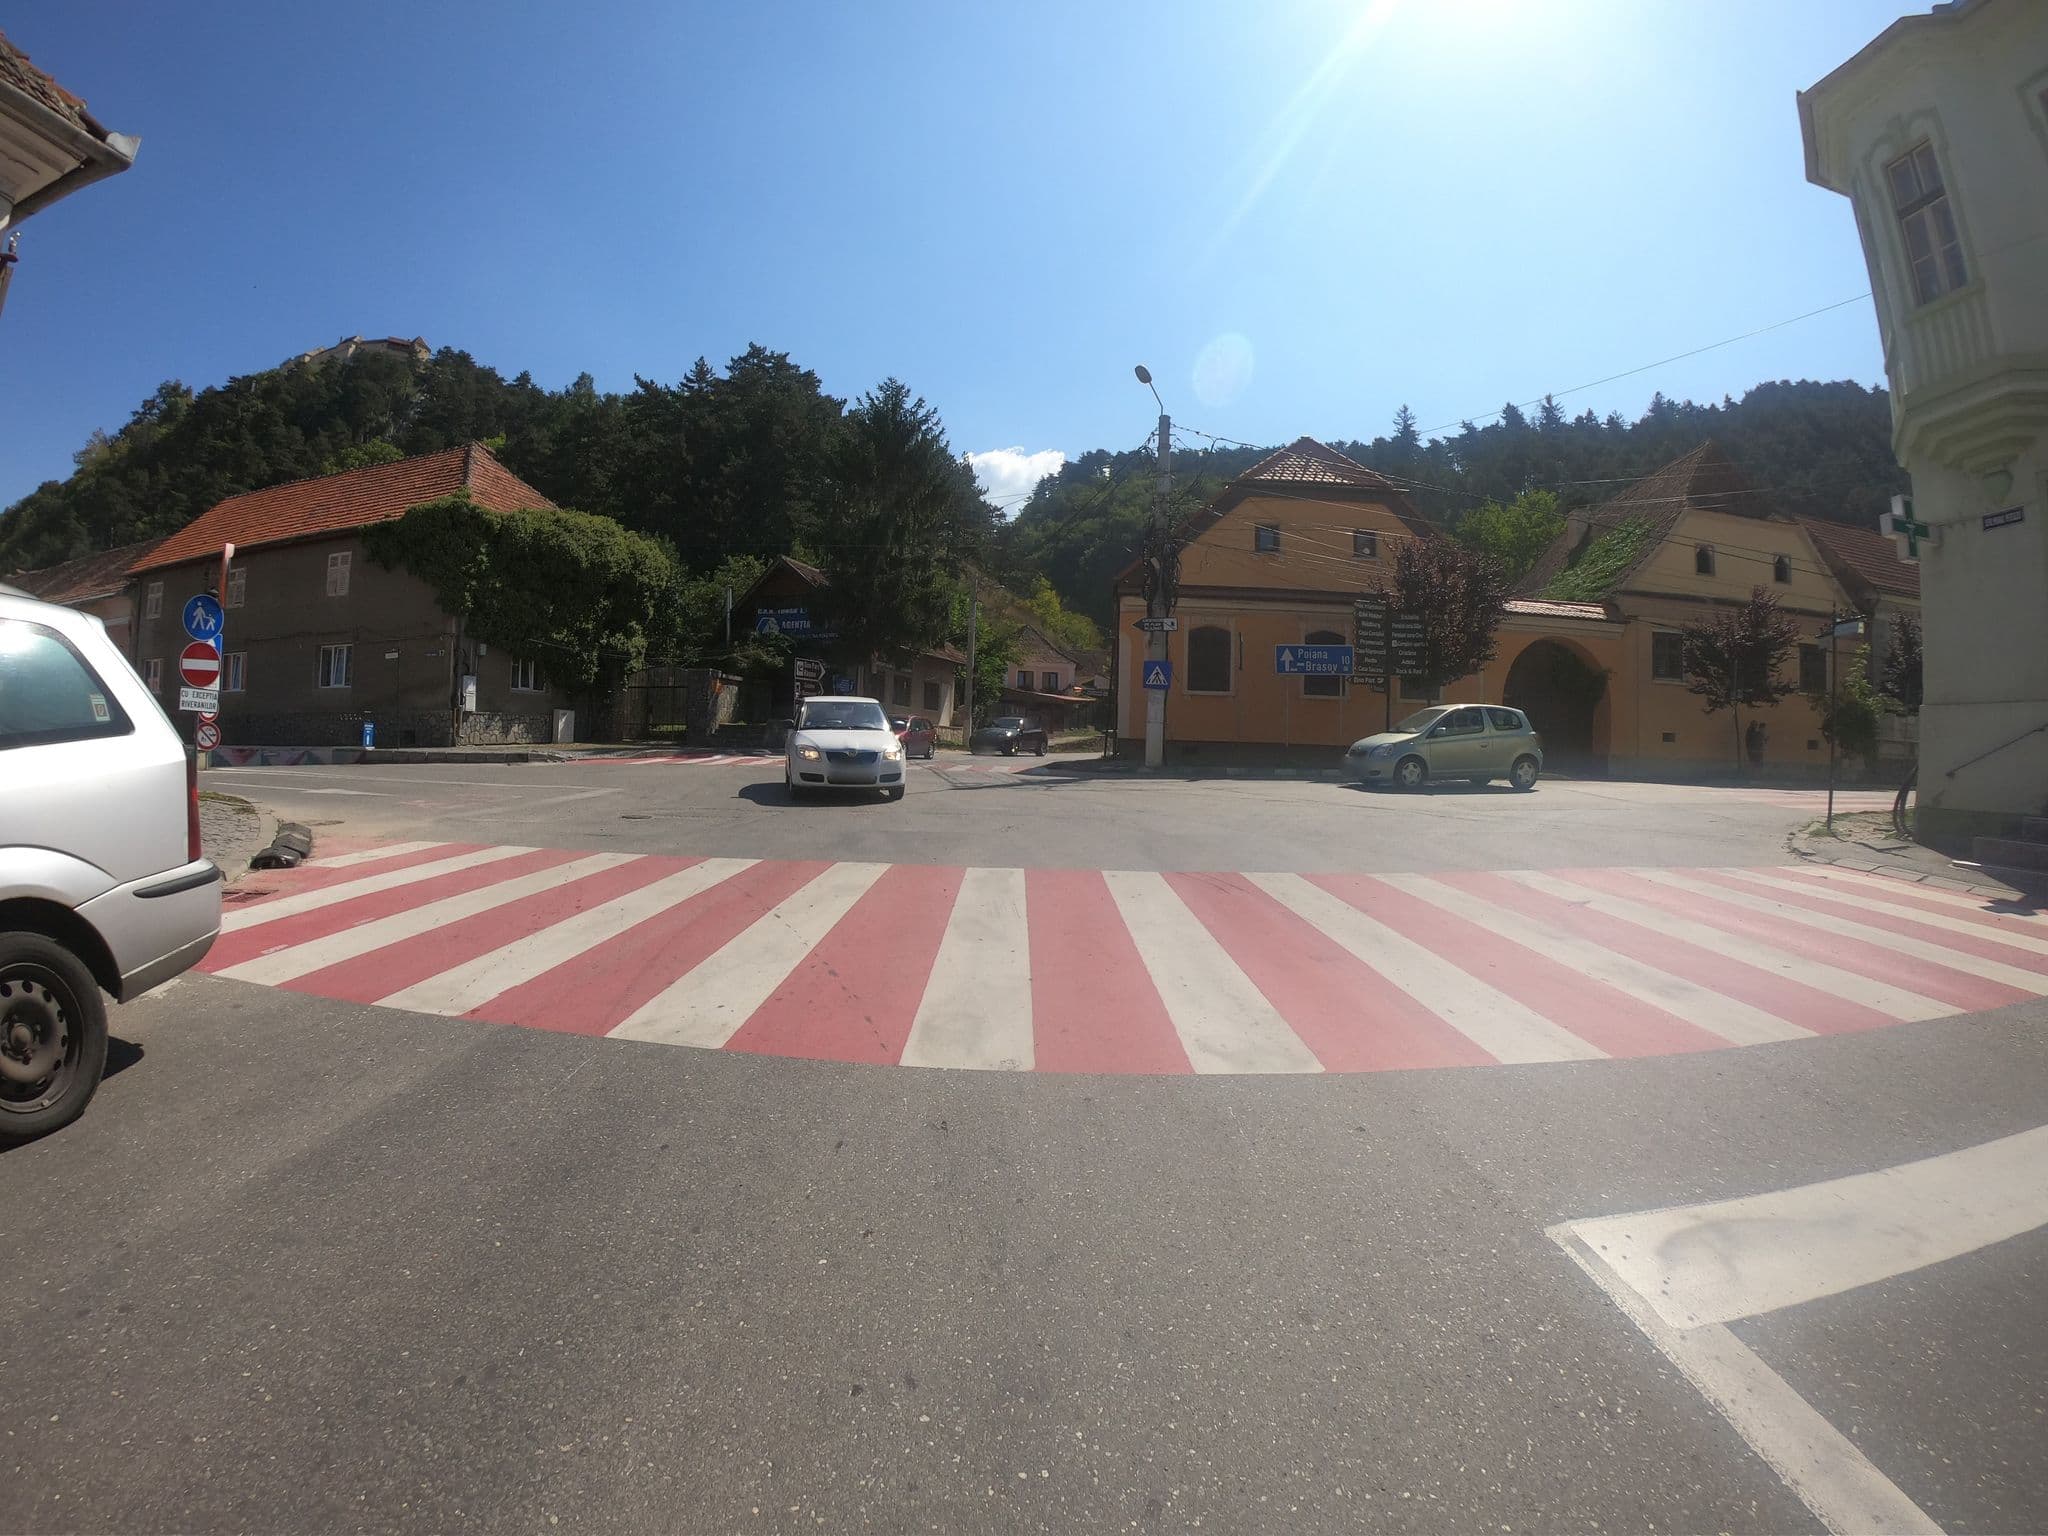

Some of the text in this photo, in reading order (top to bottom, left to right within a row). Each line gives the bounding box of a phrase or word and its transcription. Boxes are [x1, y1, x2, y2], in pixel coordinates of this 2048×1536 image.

[1297, 648, 1328, 659] Poiana
[1341, 655, 1350, 665] 10
[181, 689, 189, 698] CU
[181, 700, 217, 710] RIVERANILOR
